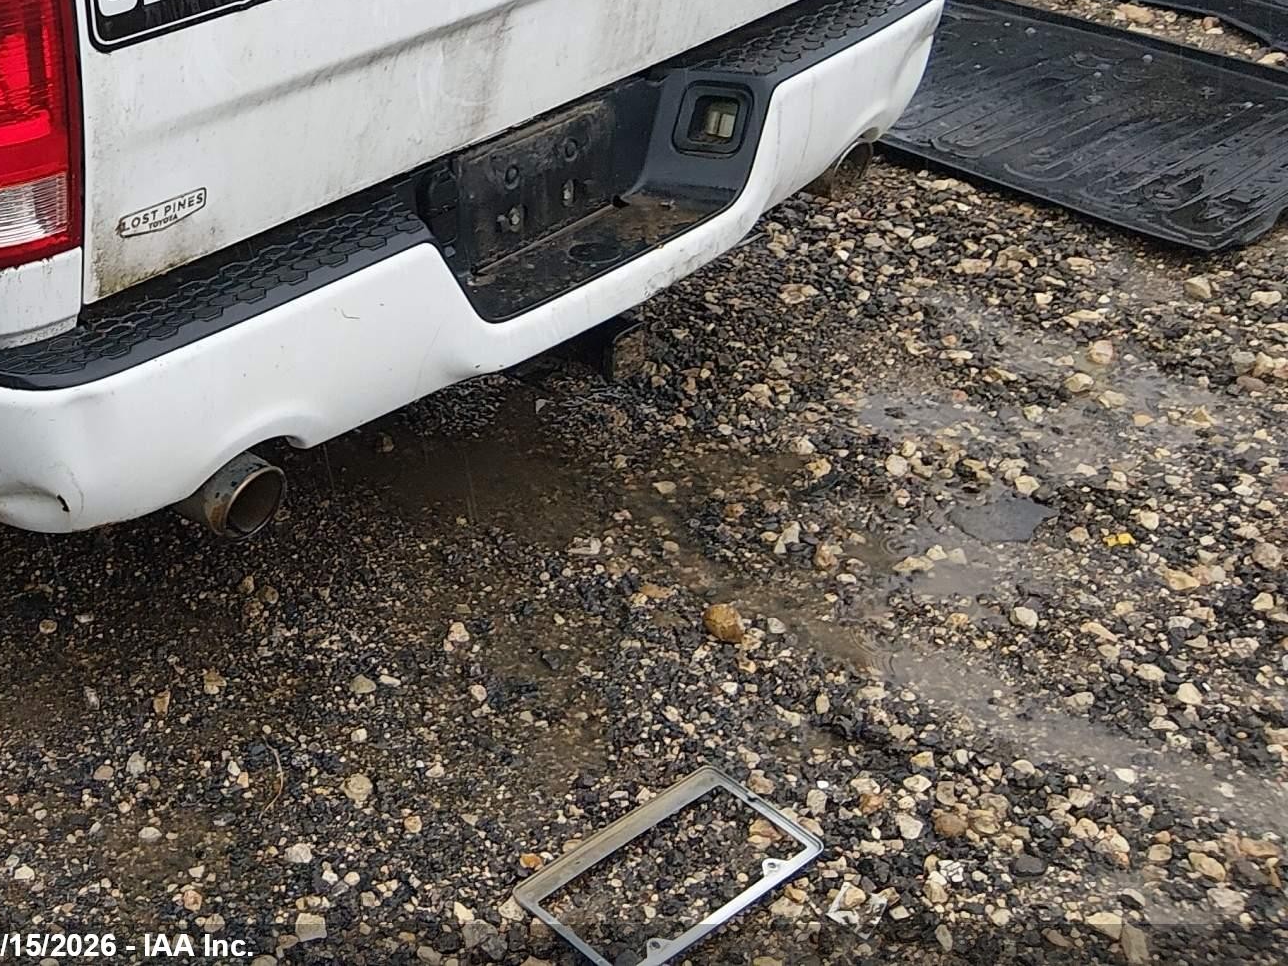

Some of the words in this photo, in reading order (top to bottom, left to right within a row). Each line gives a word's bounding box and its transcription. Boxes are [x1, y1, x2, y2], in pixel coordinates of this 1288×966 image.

[120, 209, 159, 233] LOST
[163, 192, 204, 217] PINES
[148, 213, 178, 229] TOYOTA
